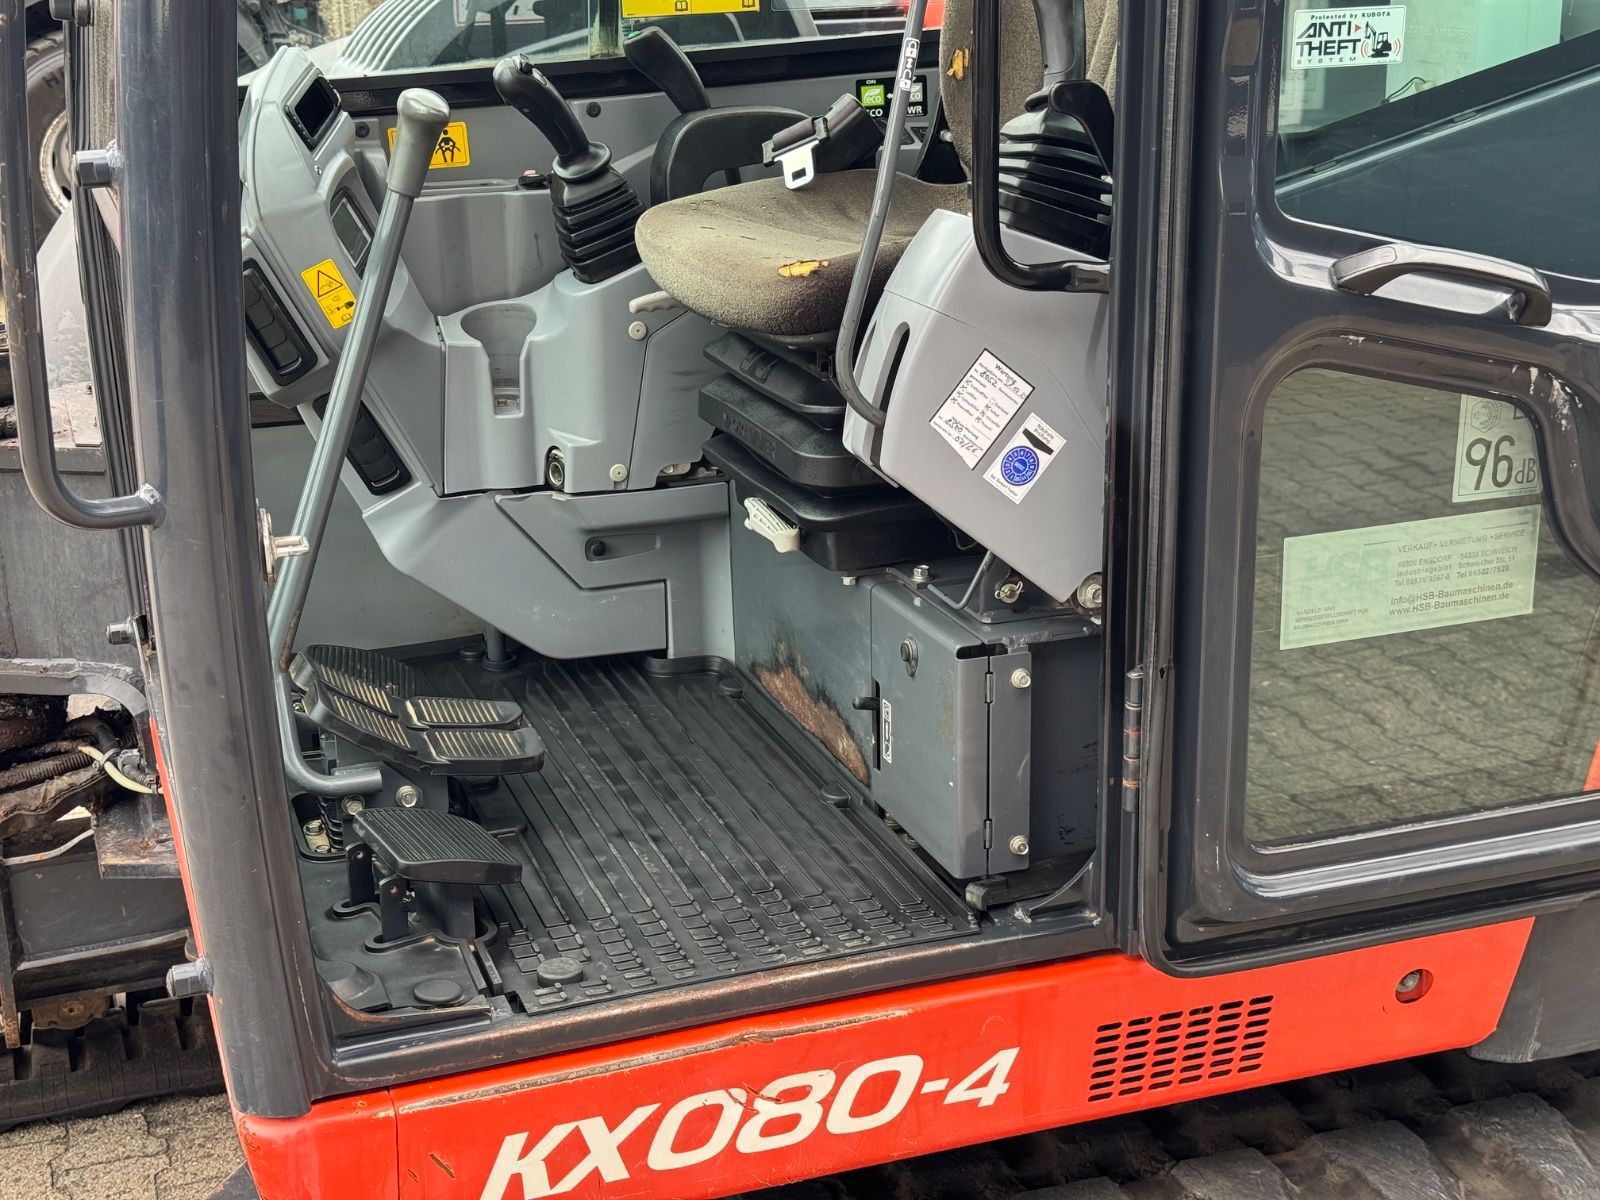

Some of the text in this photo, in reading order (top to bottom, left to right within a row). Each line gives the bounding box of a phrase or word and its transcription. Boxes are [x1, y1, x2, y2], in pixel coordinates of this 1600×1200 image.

[1361, 10, 1391, 18] KUBOTA
[1296, 20, 1352, 39] ANTI
[1295, 38, 1361, 57] THEFT
[866, 95, 882, 104] eco
[866, 108, 883, 117] CO
[1465, 434, 1536, 491] 96 dB
[1418, 555, 1452, 567] ENSDORF
[1396, 564, 1452, 578] Industriegebiet
[1390, 580, 1514, 606] info@HSB-Baumaschinen.de
[1388, 591, 1510, 616] www.HSB-Baumaschinen.de
[480, 1047, 1020, 1200] KX080-4
